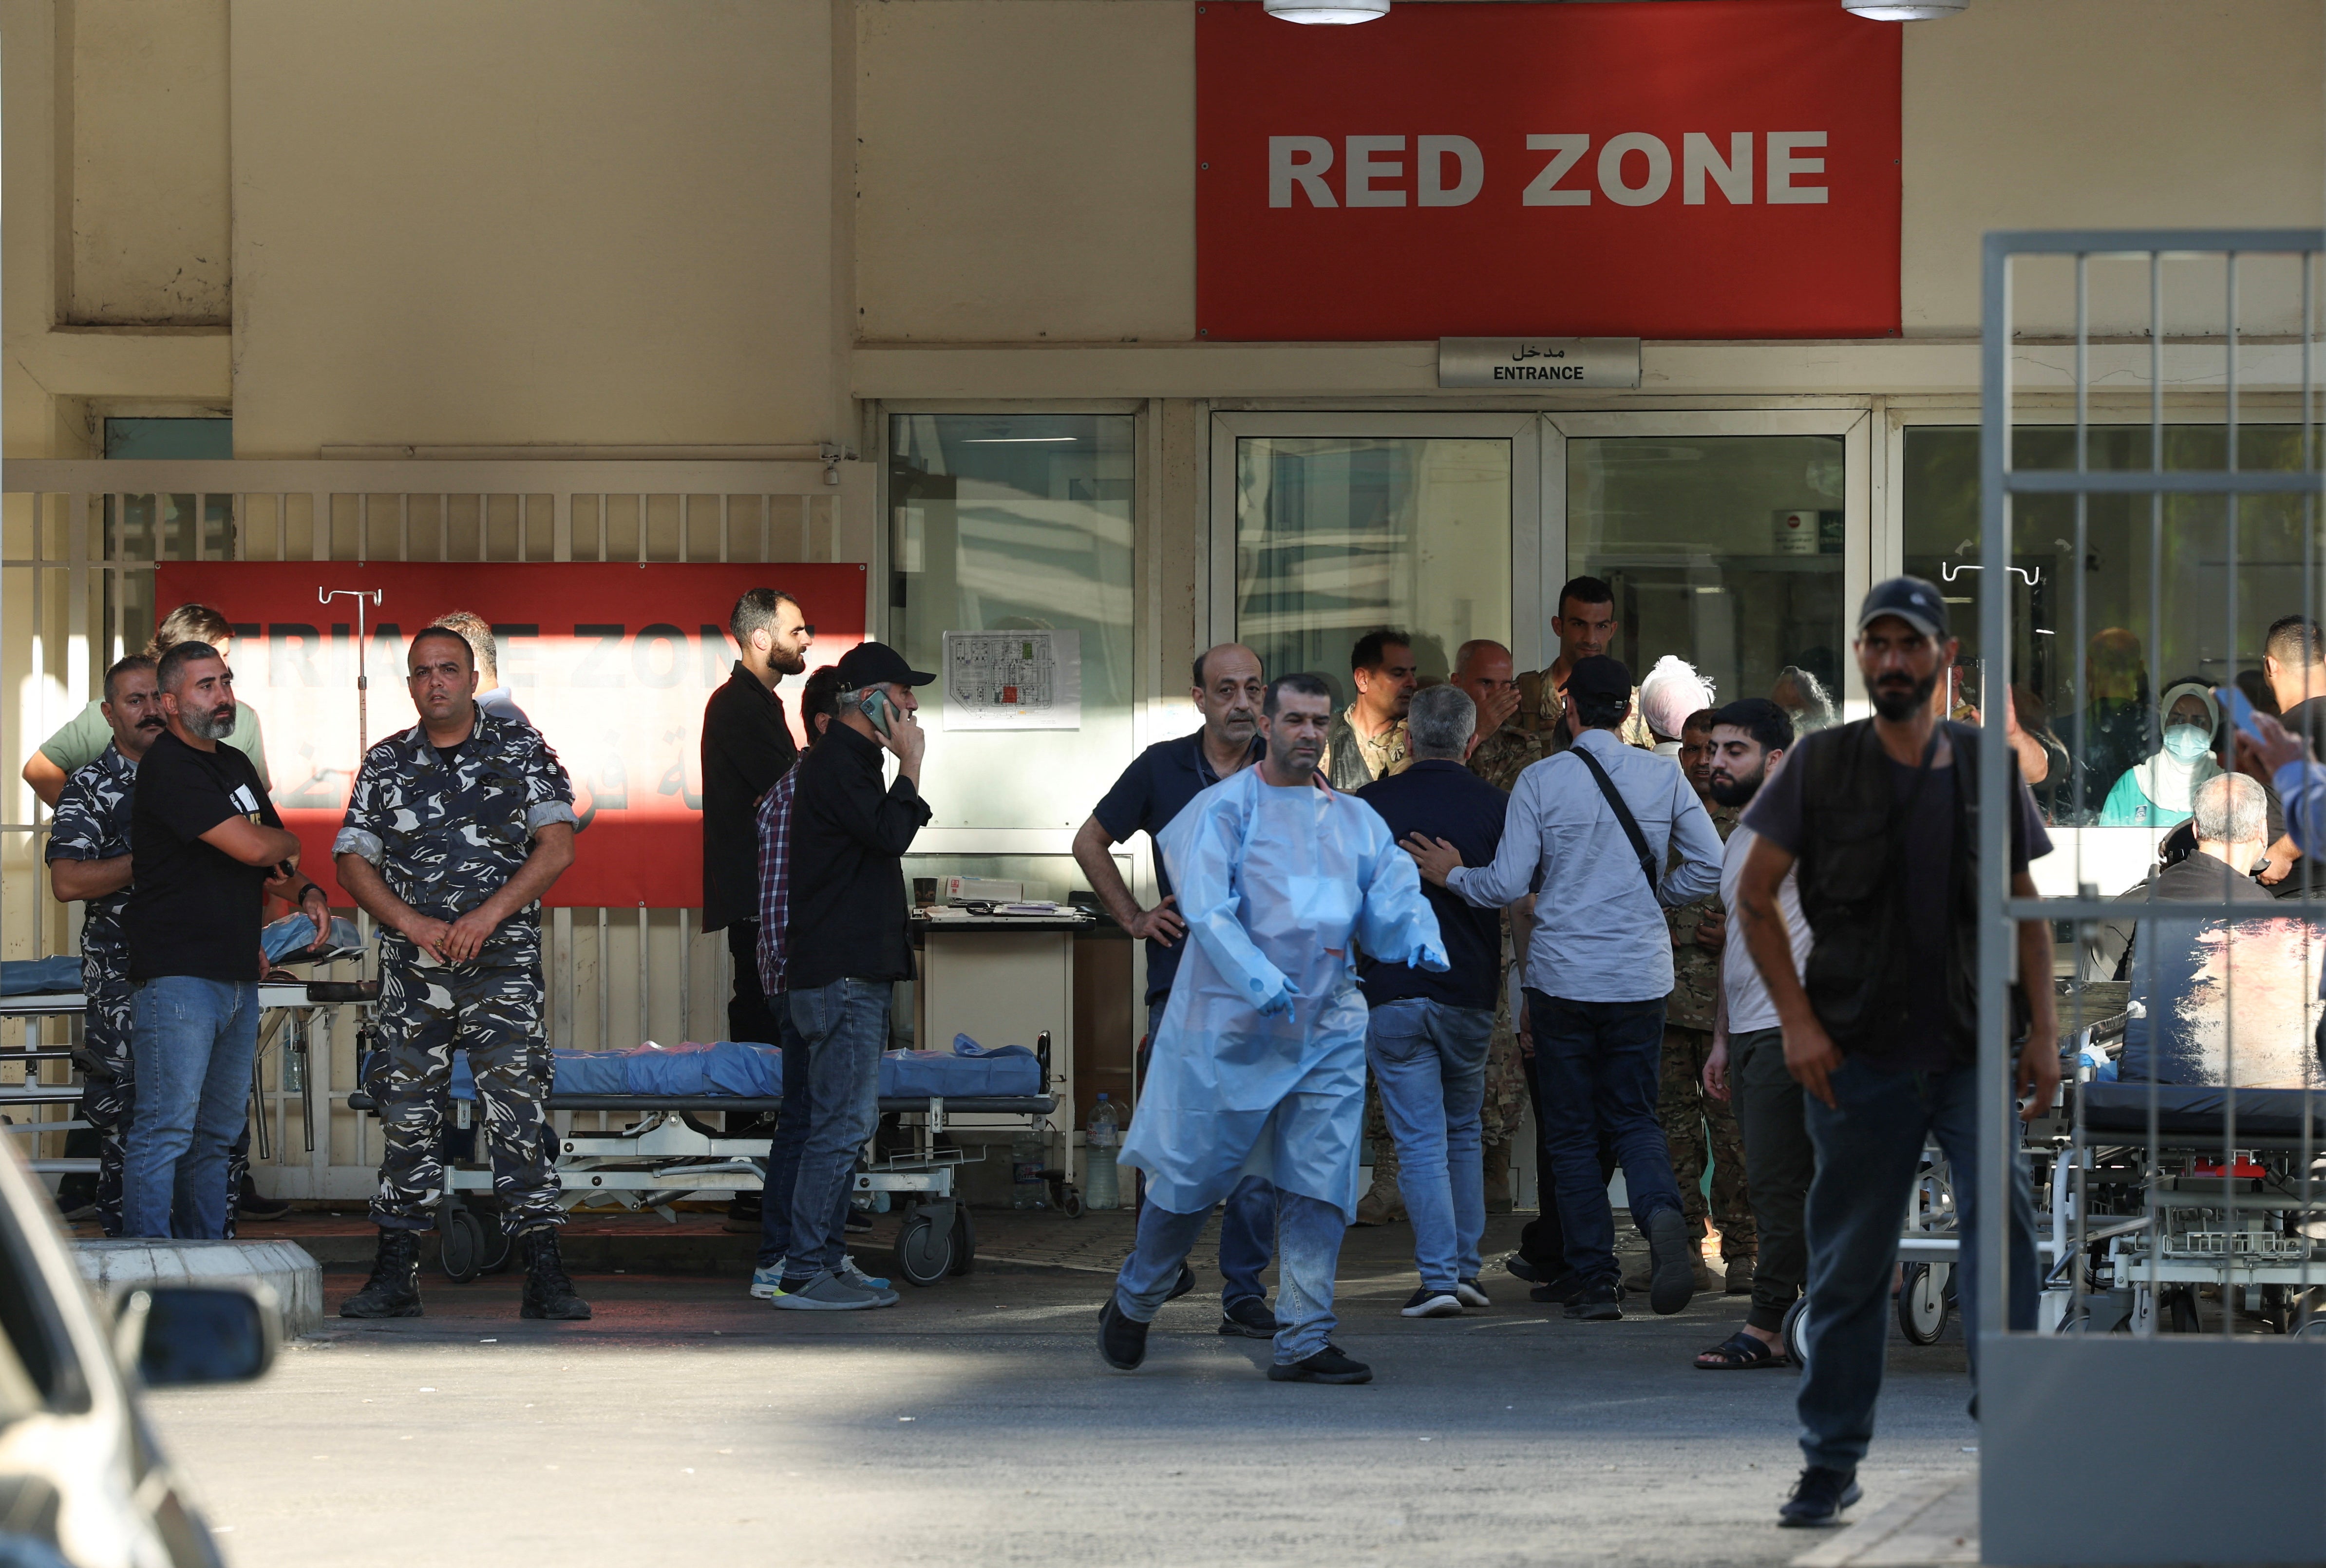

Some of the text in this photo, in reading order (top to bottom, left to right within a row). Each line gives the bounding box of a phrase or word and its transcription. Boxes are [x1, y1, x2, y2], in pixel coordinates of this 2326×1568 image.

[1269, 131, 1828, 208] RED ZONE
[1494, 366, 1584, 380] ENTRANCE
[1512, 344, 1565, 362] مدخل
[227, 623, 539, 688] TRIAE
